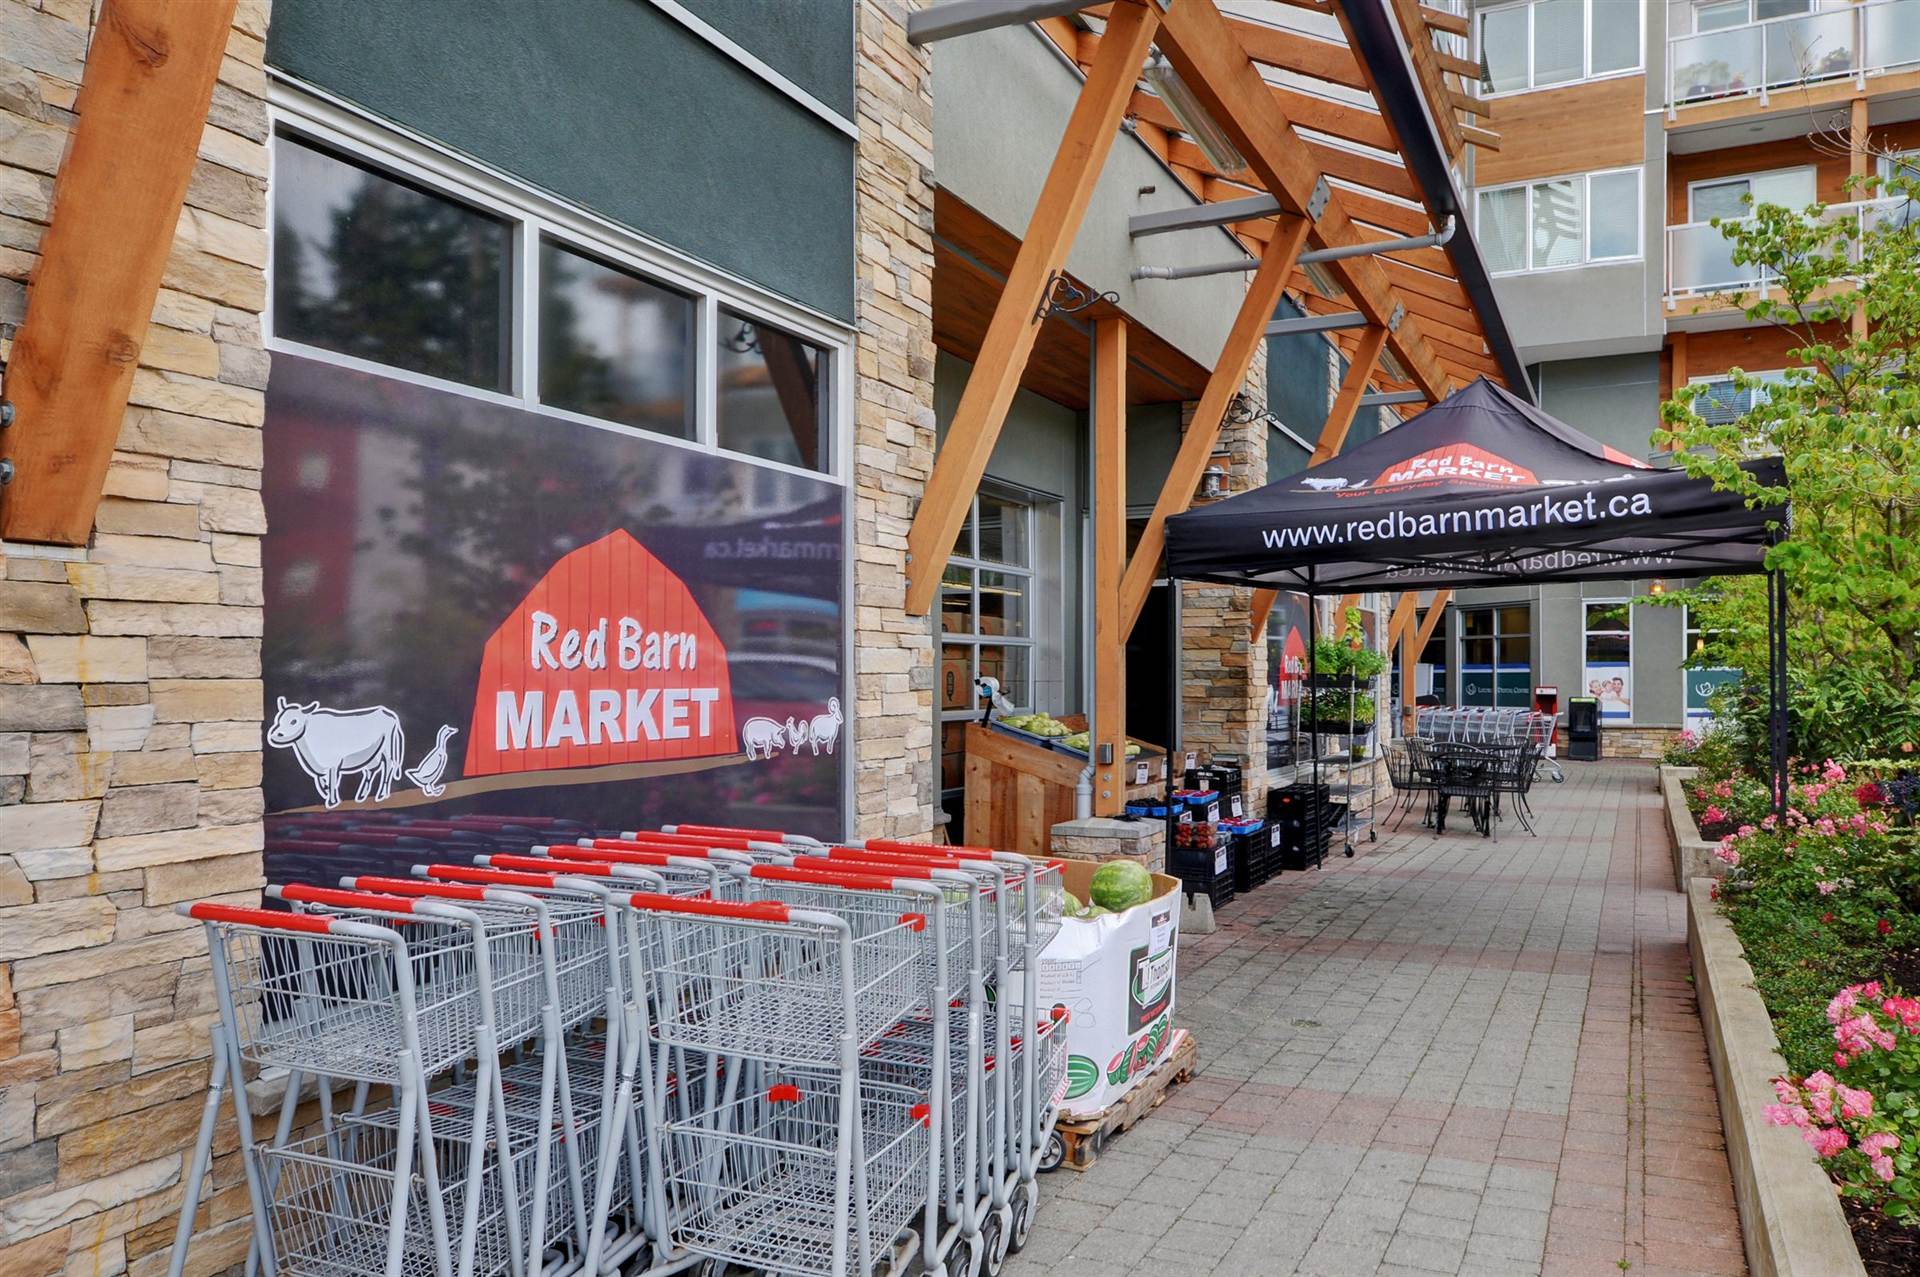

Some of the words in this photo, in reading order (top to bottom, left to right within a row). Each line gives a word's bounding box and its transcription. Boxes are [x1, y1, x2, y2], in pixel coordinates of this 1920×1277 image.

[1387, 466, 1526, 483] MARKET
[1411, 455, 1453, 470] Red
[1459, 455, 1514, 474] Barn
[1262, 491, 1652, 549] www.redbarnmarket.ca
[531, 610, 609, 671] Red
[618, 616, 698, 671] Barn
[494, 687, 720, 752] MARKET
